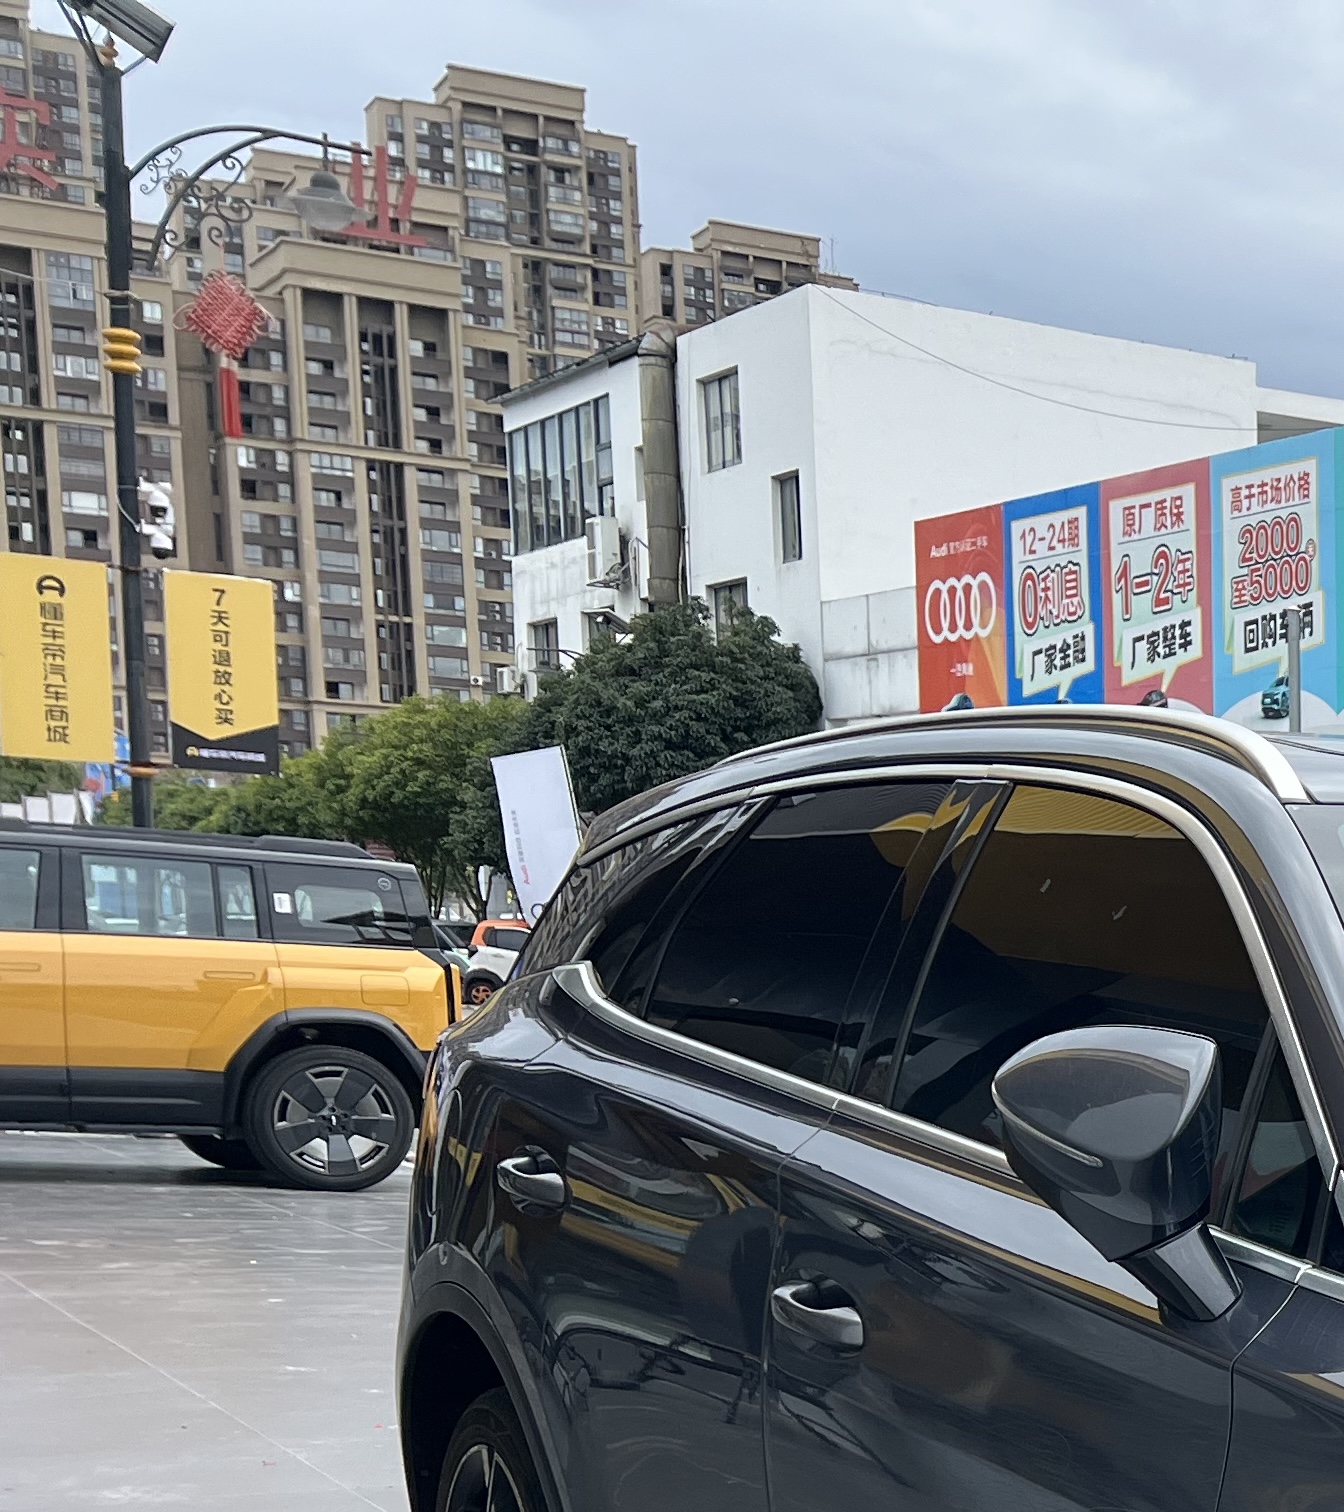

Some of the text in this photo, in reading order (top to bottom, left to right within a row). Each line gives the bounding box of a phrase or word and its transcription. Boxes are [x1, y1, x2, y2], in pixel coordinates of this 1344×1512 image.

[1122, 495, 1185, 538] 原厂质保
[1230, 470, 1311, 515] 高于市场价格
[1019, 516, 1080, 557] 12-24期
[1238, 512, 1302, 568] 2000
[1017, 560, 1086, 637] 0利息
[1115, 543, 1195, 622] 1-2年
[1231, 552, 1313, 609] 至5000
[210, 587, 235, 726] 7天可退放心买
[1030, 631, 1086, 682] 厂家金融
[1131, 618, 1194, 671] 厂家整车
